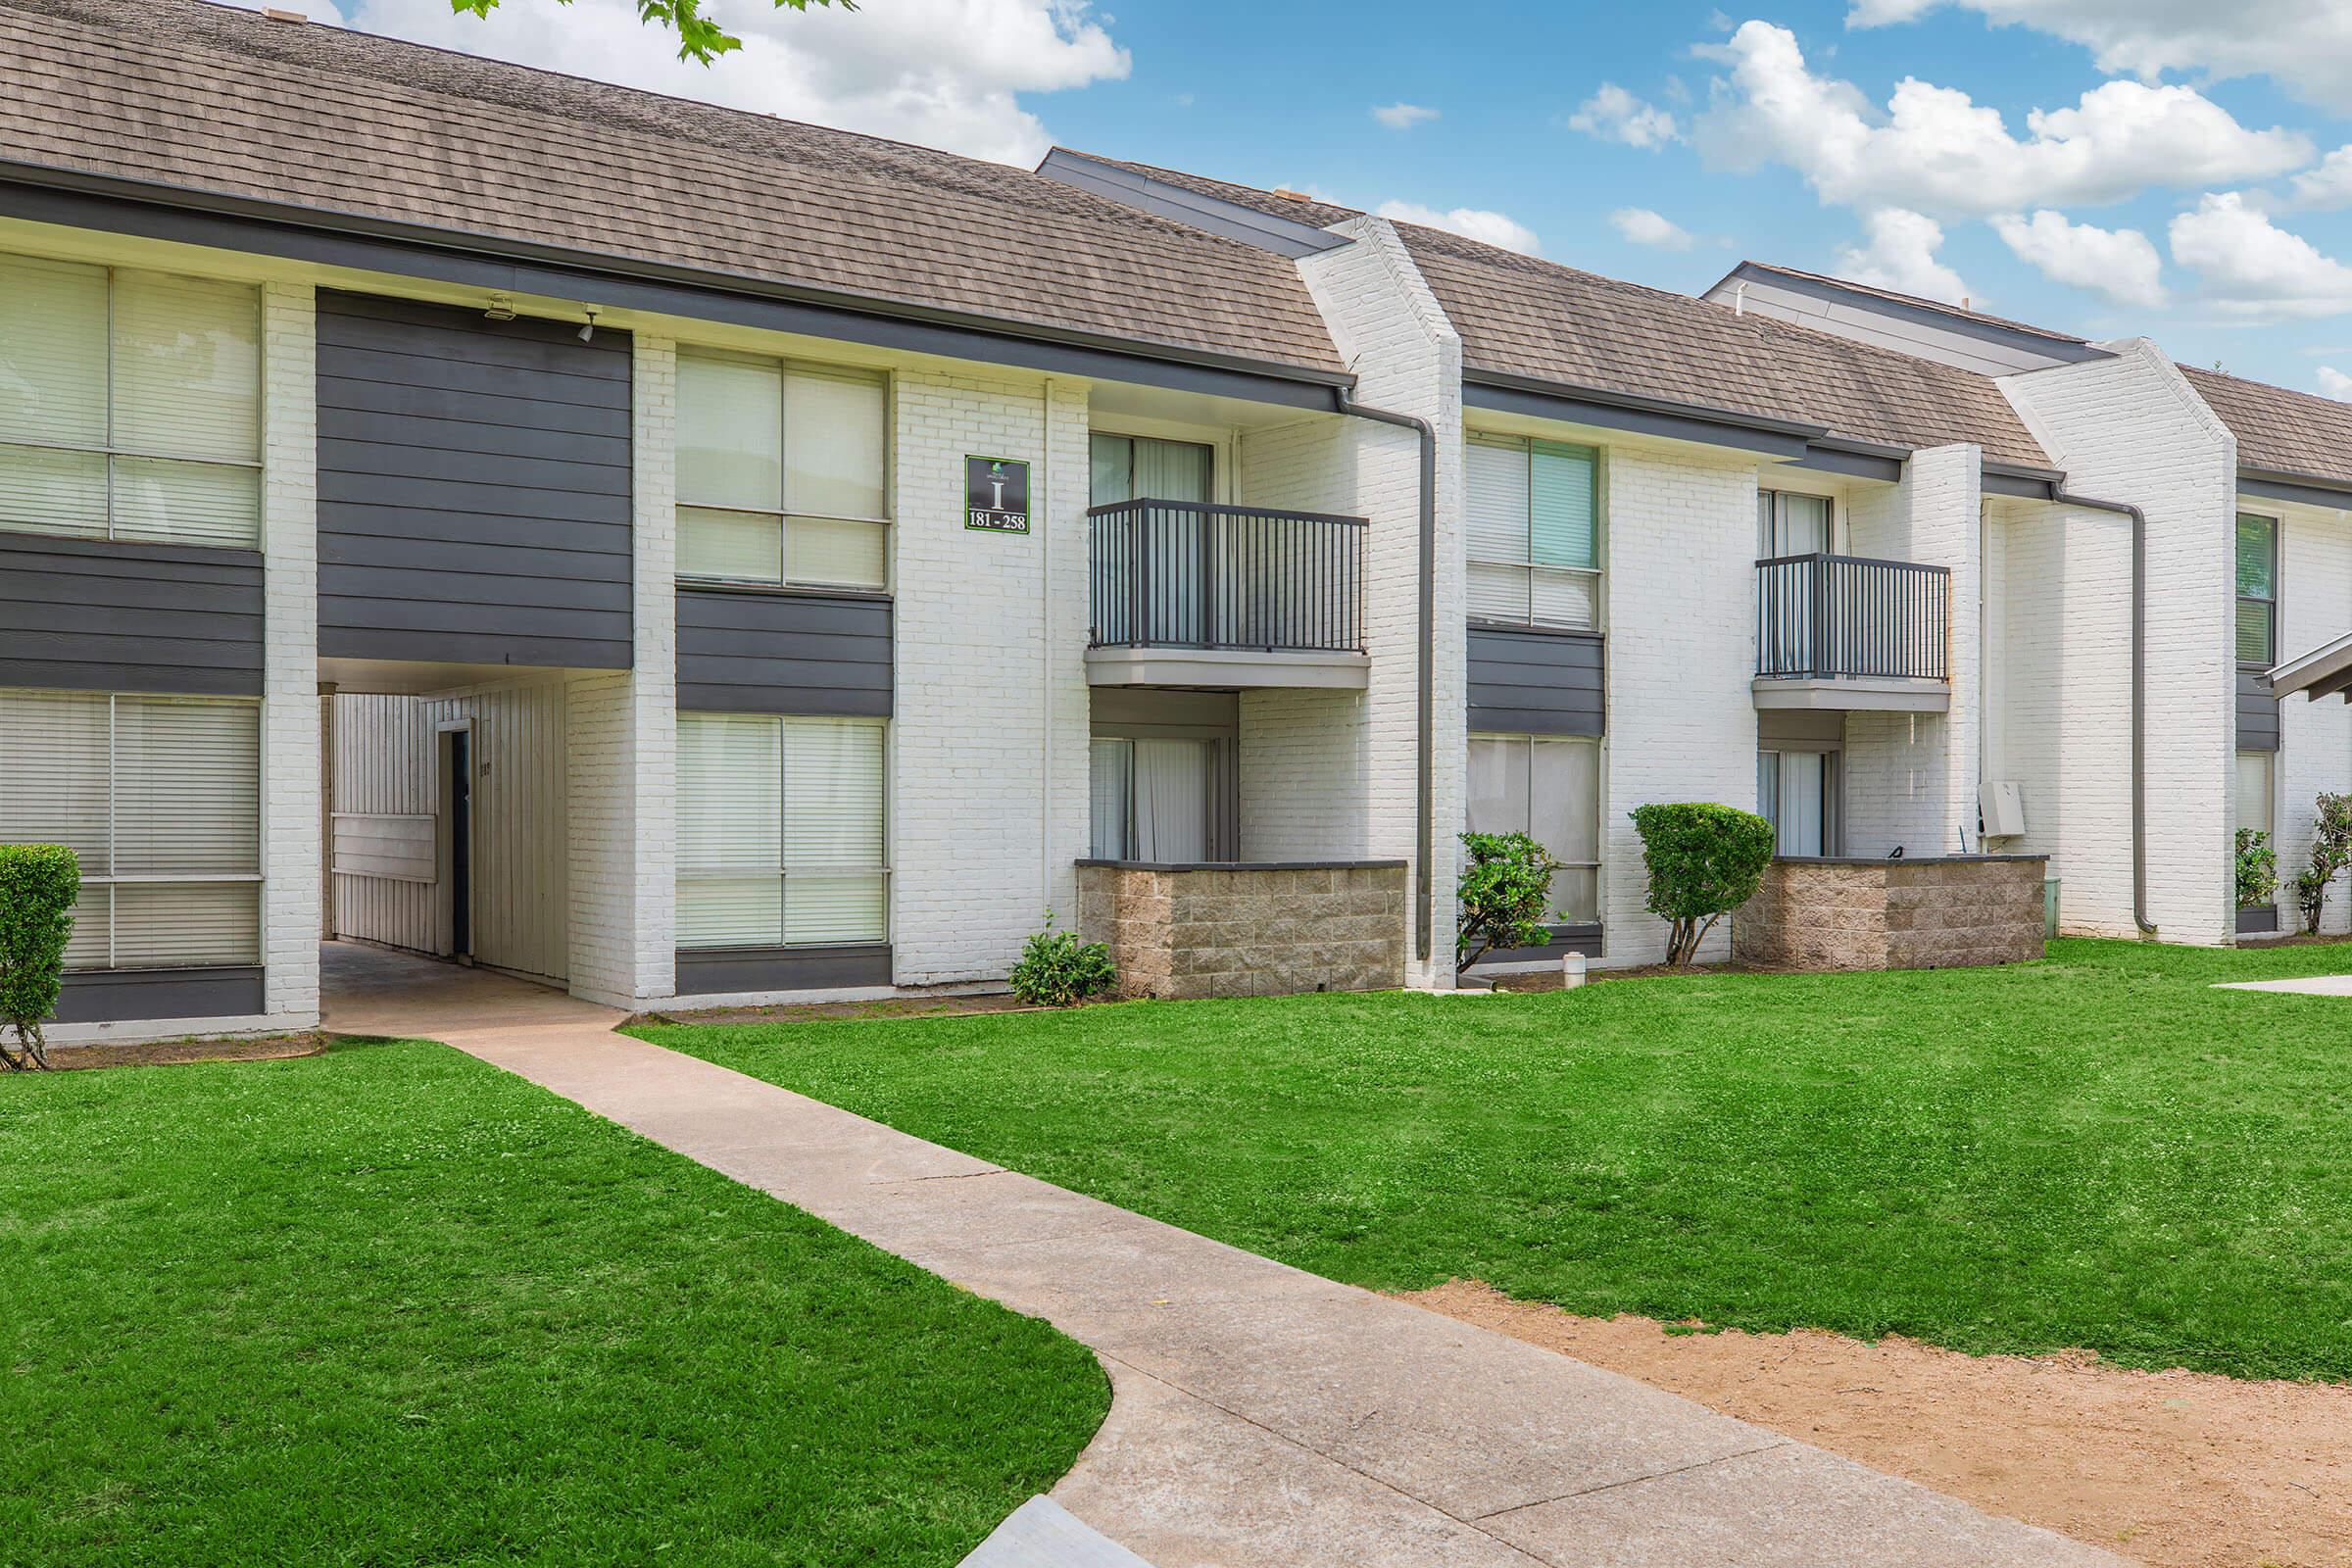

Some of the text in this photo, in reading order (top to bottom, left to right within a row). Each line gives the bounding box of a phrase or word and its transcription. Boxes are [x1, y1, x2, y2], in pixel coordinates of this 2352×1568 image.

[991, 482, 1004, 510] I
[970, 512, 991, 526] 181
[1003, 514, 1025, 530] 258
